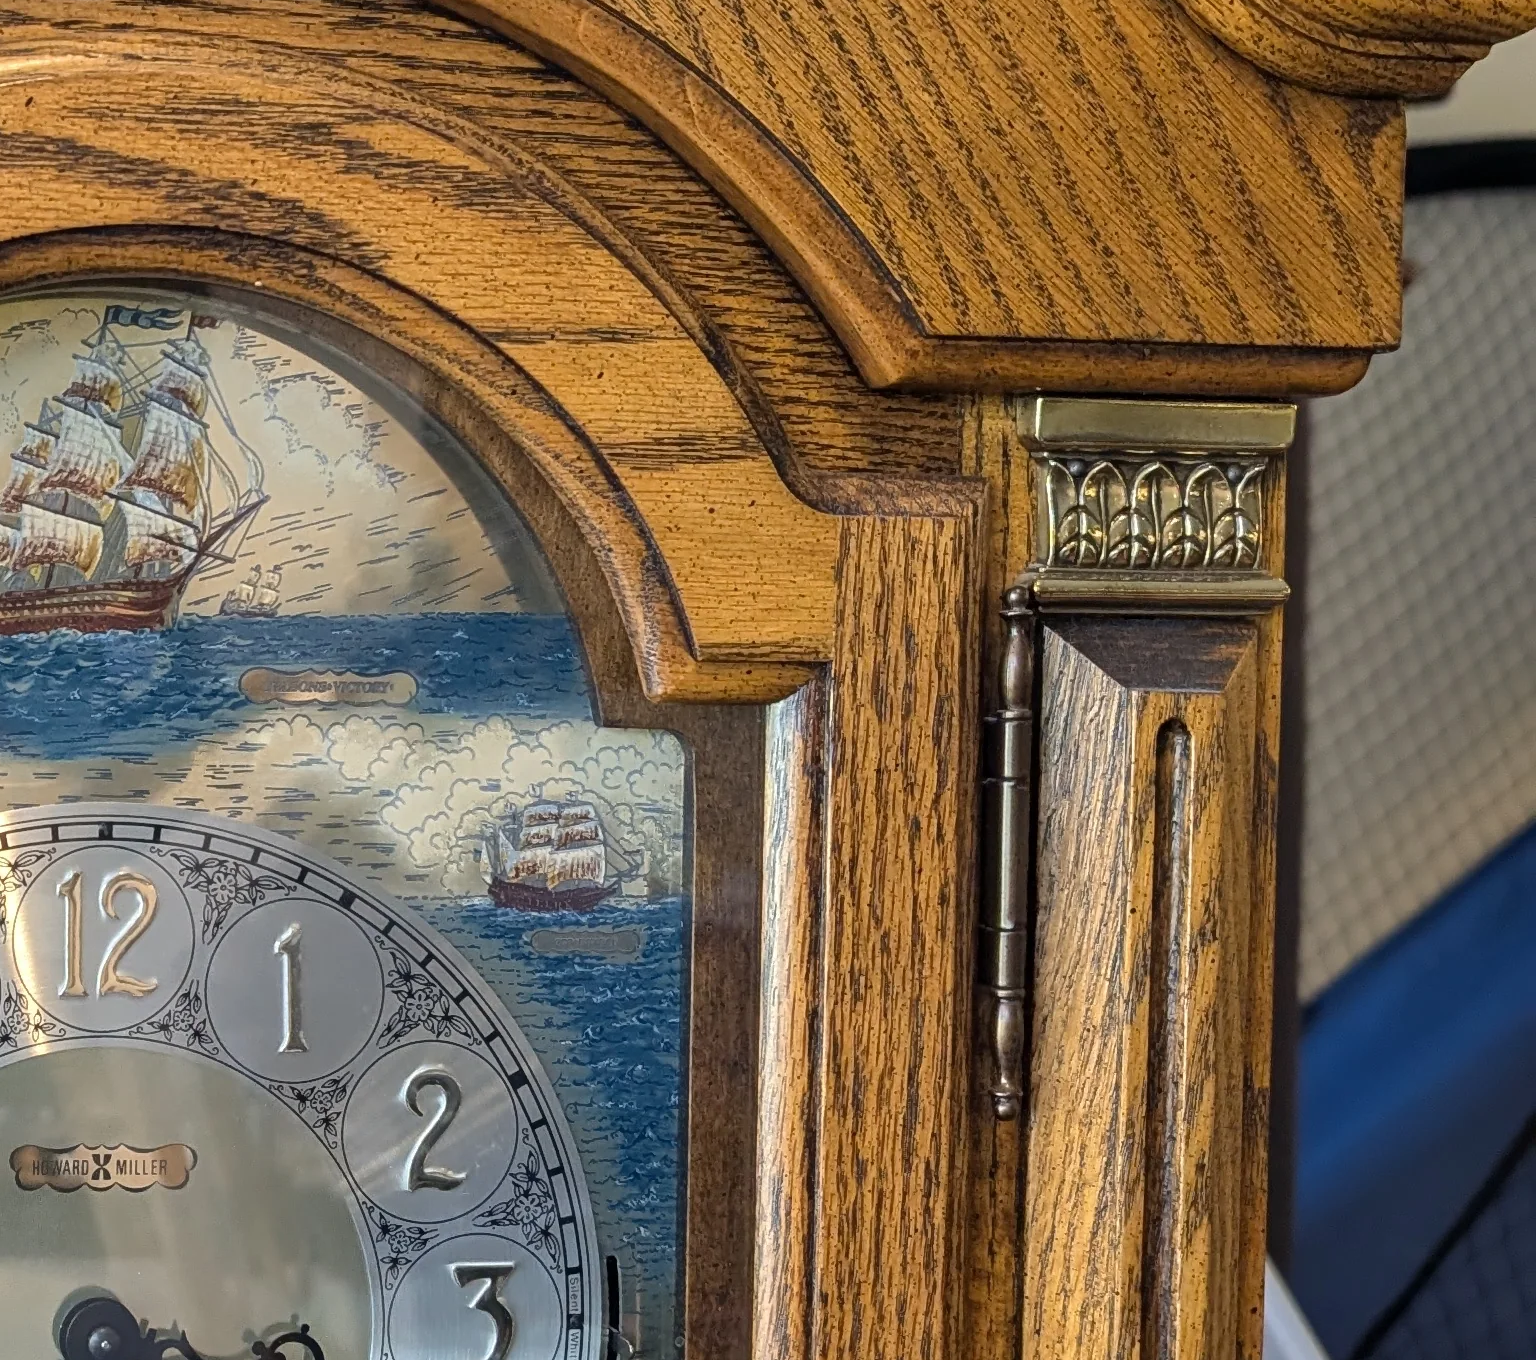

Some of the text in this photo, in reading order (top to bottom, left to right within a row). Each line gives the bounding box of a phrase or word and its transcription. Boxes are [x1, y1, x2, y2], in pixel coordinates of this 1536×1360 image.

[57, 870, 159, 998] 12
[273, 922, 308, 1054] 1
[32, 1159, 169, 1177] HOWARD MILLER
[404, 1066, 467, 1193] 2
[569, 1277, 581, 1314] Silent
